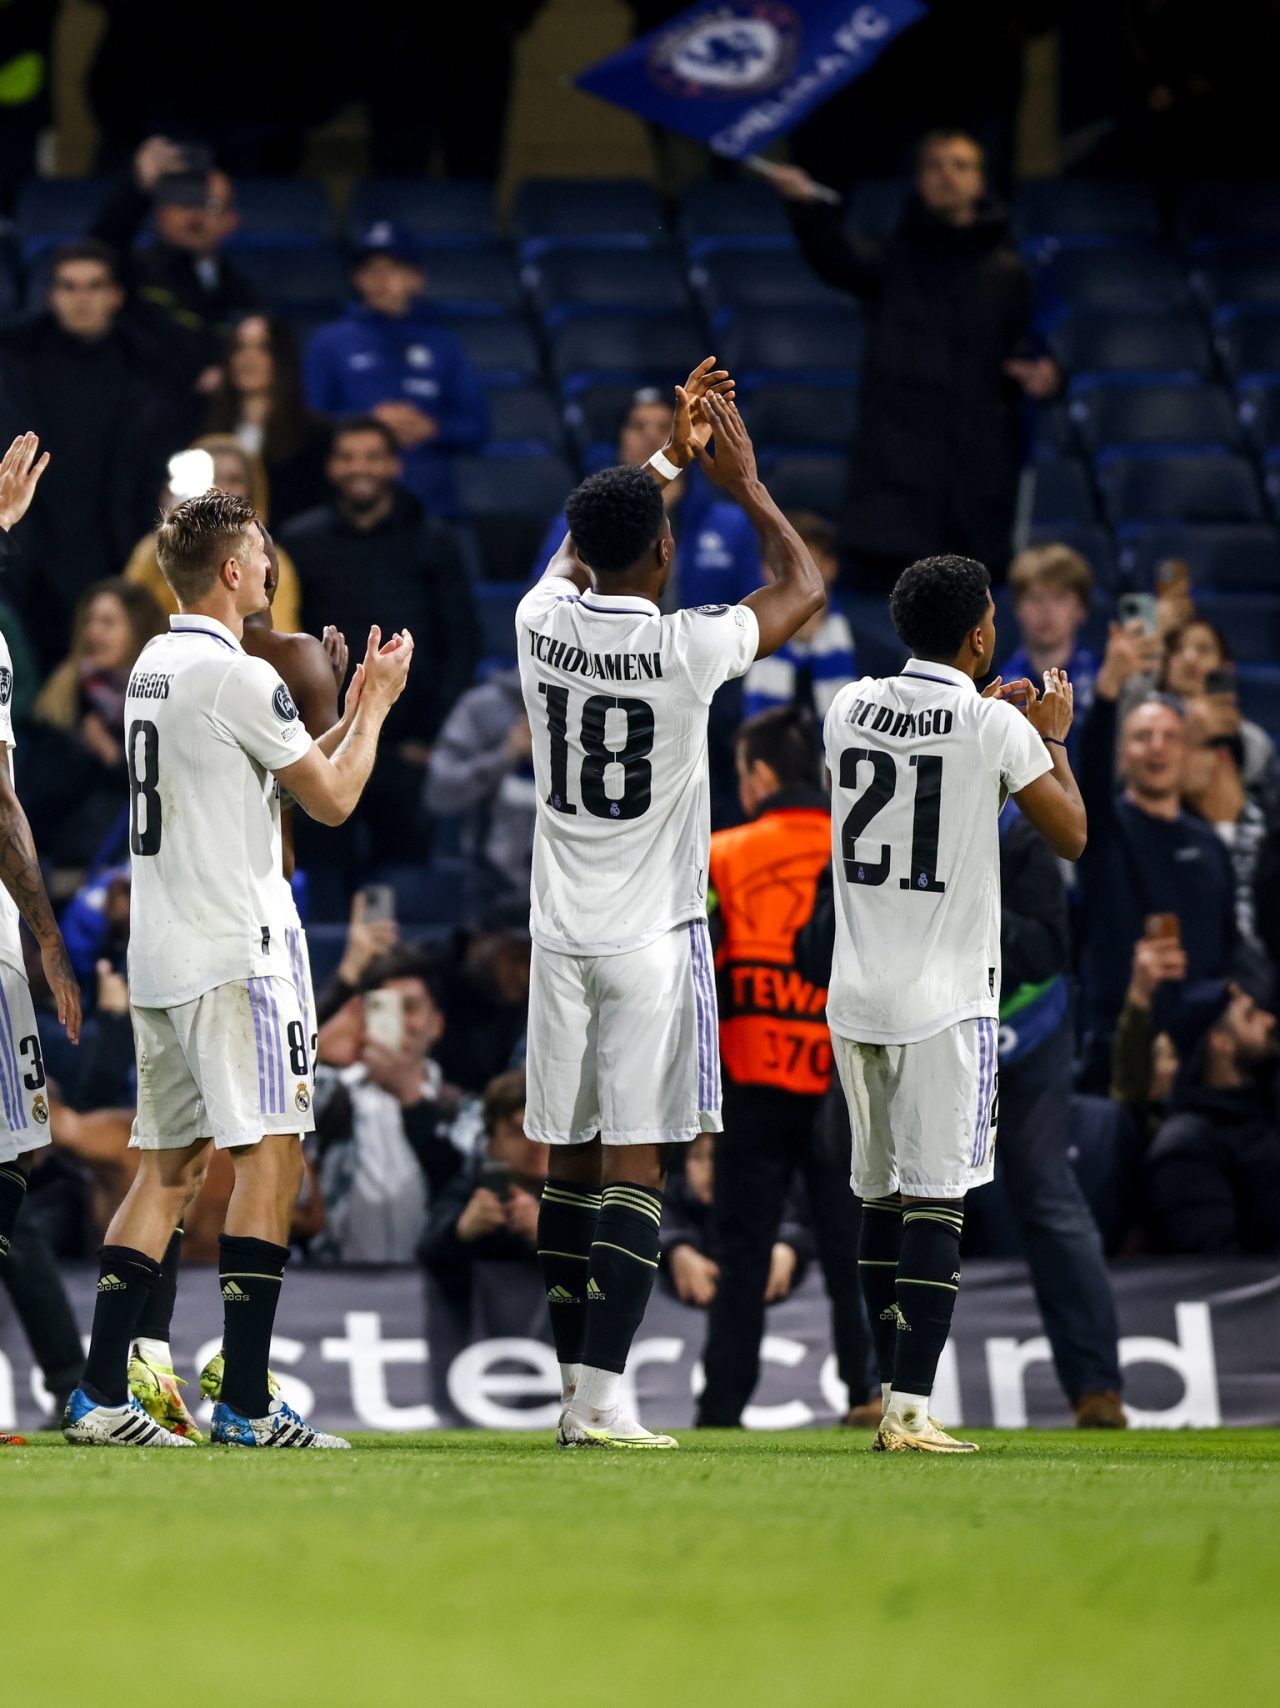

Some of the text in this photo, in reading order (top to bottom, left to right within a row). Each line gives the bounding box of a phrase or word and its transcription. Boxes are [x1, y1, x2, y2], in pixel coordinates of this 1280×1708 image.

[529, 629, 663, 681] TCHOUAMENI
[128, 672, 173, 700] KROOS
[538, 681, 655, 820] 18
[128, 719, 163, 856] 8
[839, 747, 946, 893] 21
[19, 1034, 46, 1091] 3
[287, 1020, 308, 1076] 8
